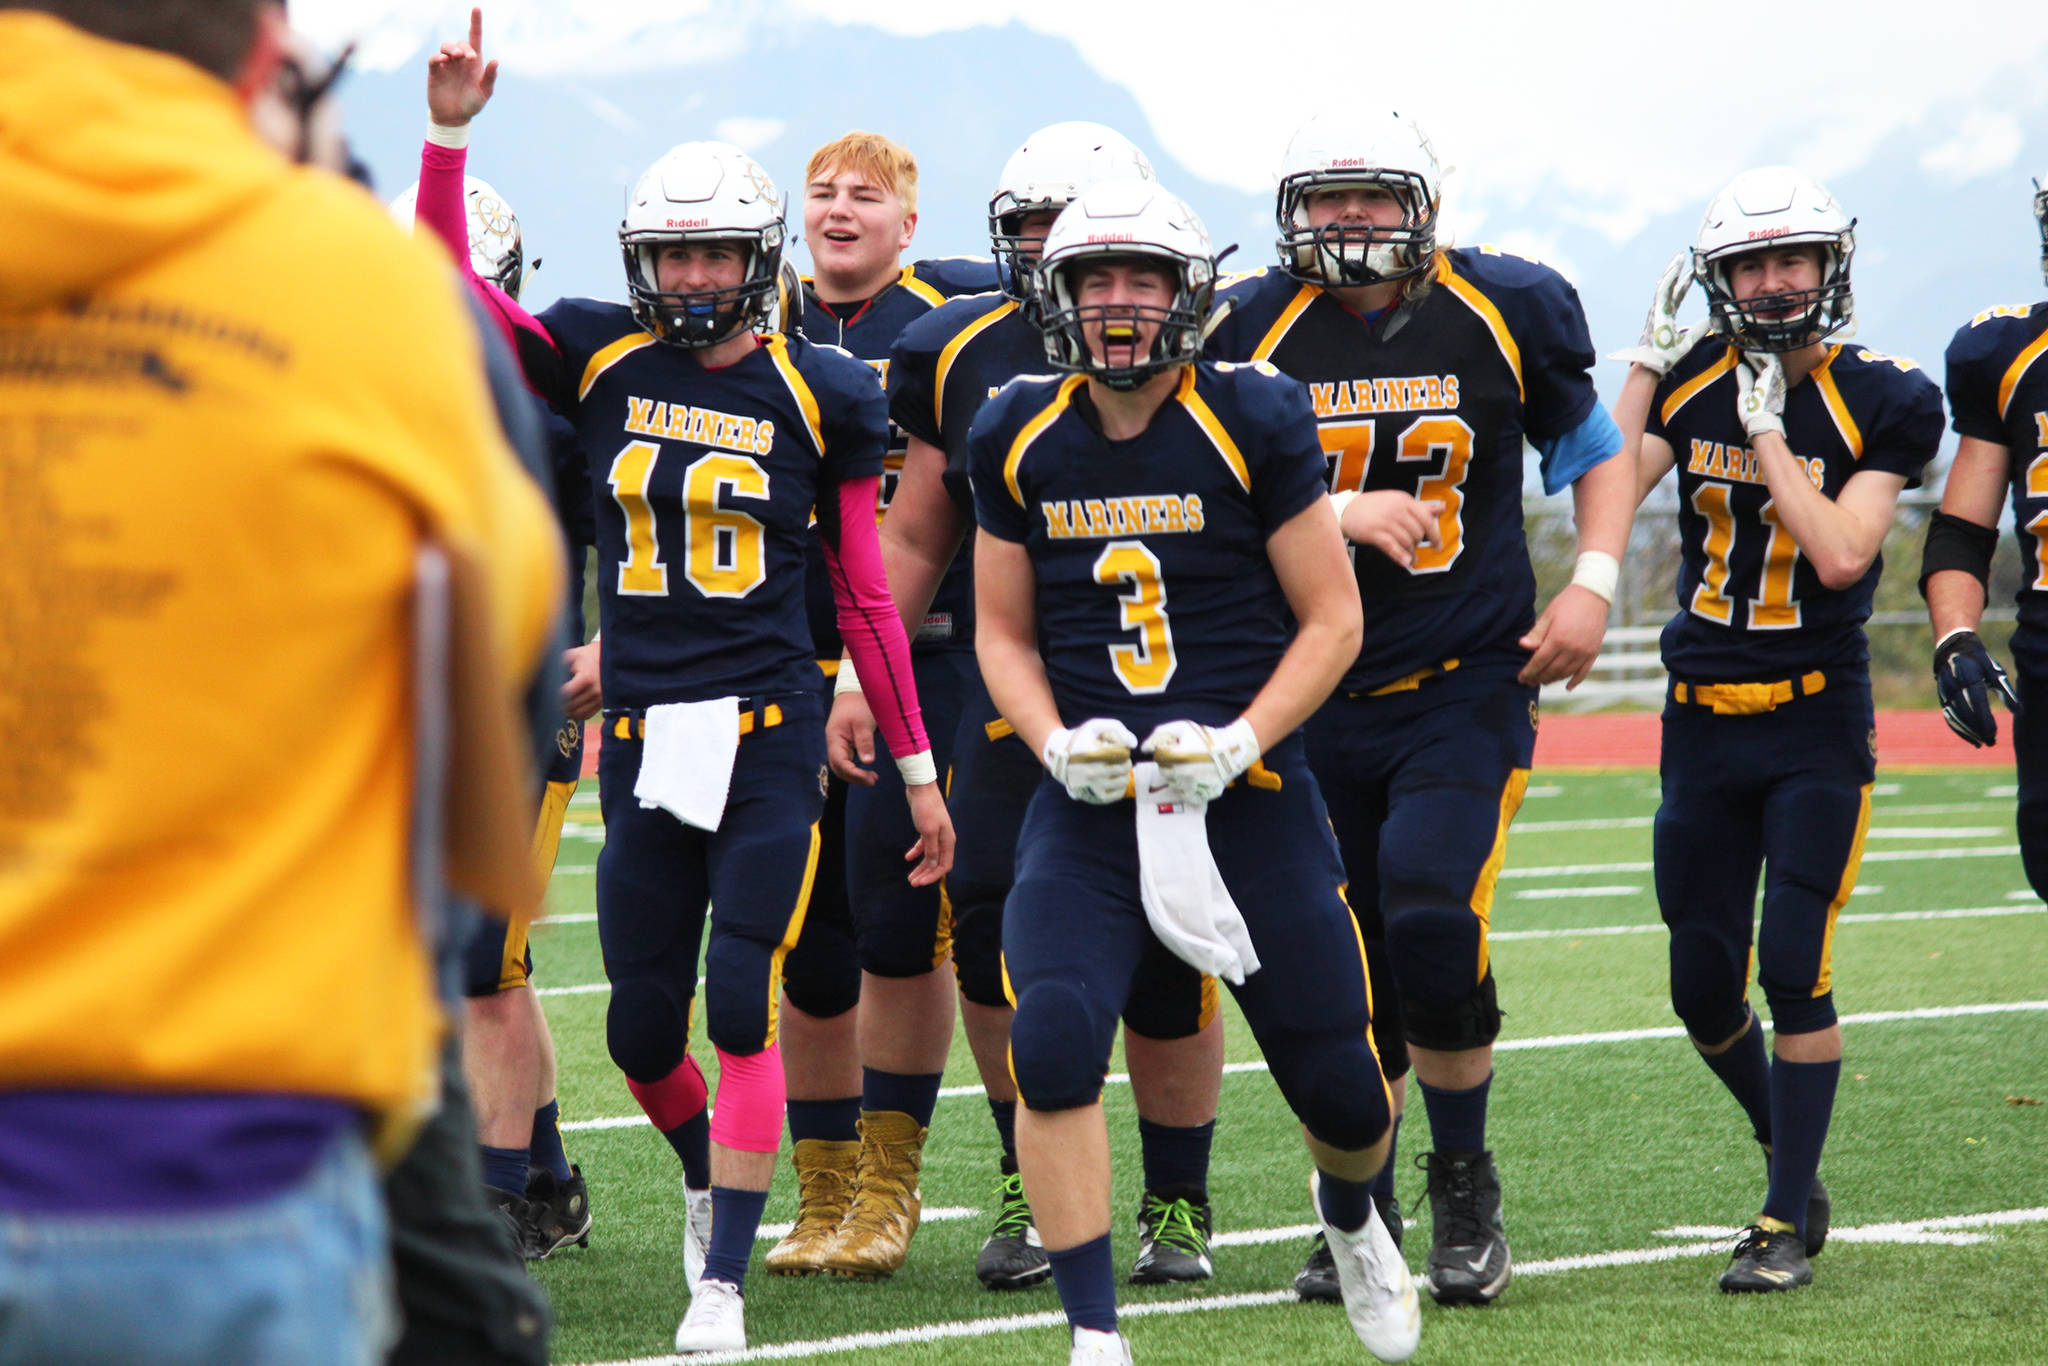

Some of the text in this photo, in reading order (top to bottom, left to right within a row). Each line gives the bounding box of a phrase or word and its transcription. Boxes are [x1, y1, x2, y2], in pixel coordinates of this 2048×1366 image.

[1332, 157, 1365, 168] Riddell
[666, 218, 708, 228] Riddell
[1748, 225, 1790, 241] Riddell
[1309, 375, 1460, 418] MARINERS
[624, 396, 775, 456] MARINERS
[607, 440, 770, 599] 16
[1041, 493, 1205, 539] MARINERS
[1317, 414, 1476, 575] 73
[1690, 481, 1803, 631] 11
[1093, 540, 1178, 696] 3
